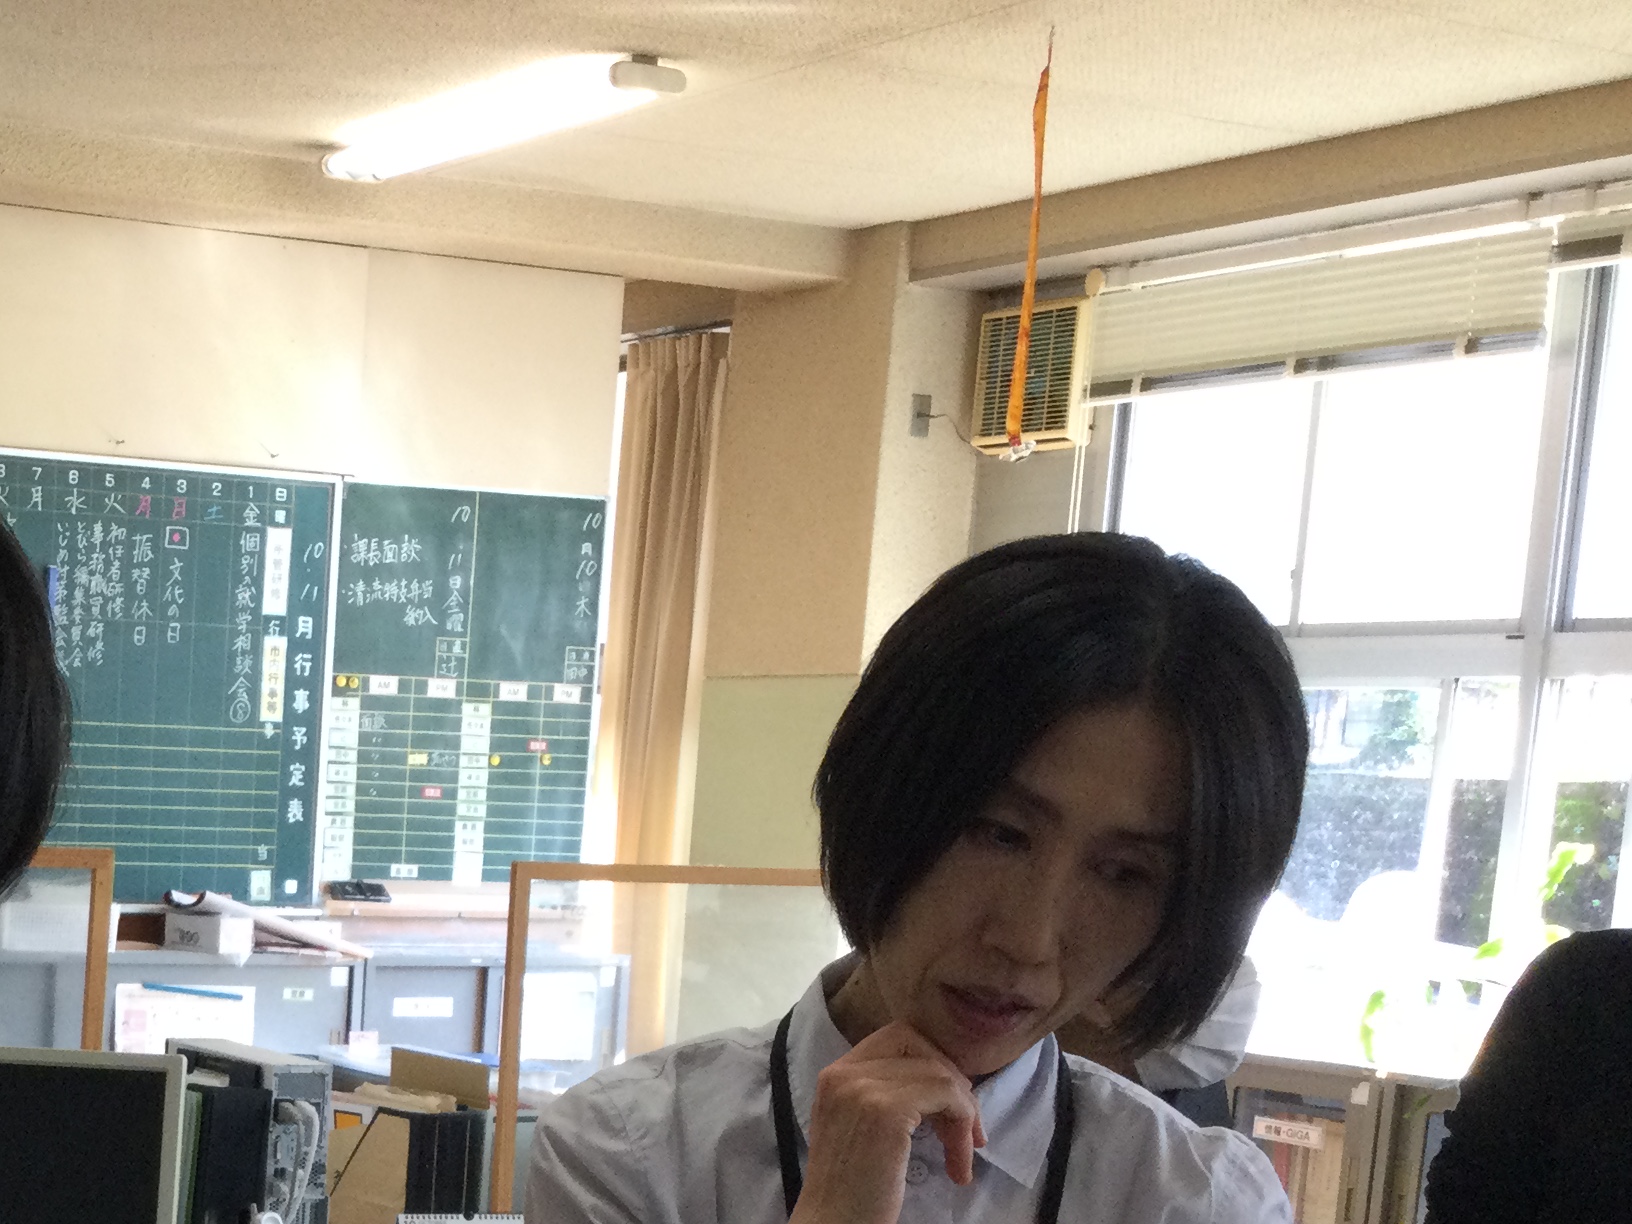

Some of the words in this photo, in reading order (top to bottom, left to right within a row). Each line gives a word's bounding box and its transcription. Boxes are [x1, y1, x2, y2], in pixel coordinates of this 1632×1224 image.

[31, 467, 42, 481] 7
[105, 473, 115, 487] 5
[141, 477, 151, 490] 4
[176, 479, 187, 492] 3
[212, 482, 222, 496] 2
[248, 485, 254, 498] 1
[26, 486, 43, 511] 月
[64, 488, 87, 515] 水
[104, 493, 127, 514] 火
[242, 502, 261, 527] 金
[131, 534, 155, 646] 振替休日
[163, 557, 184, 644] 文化の日
